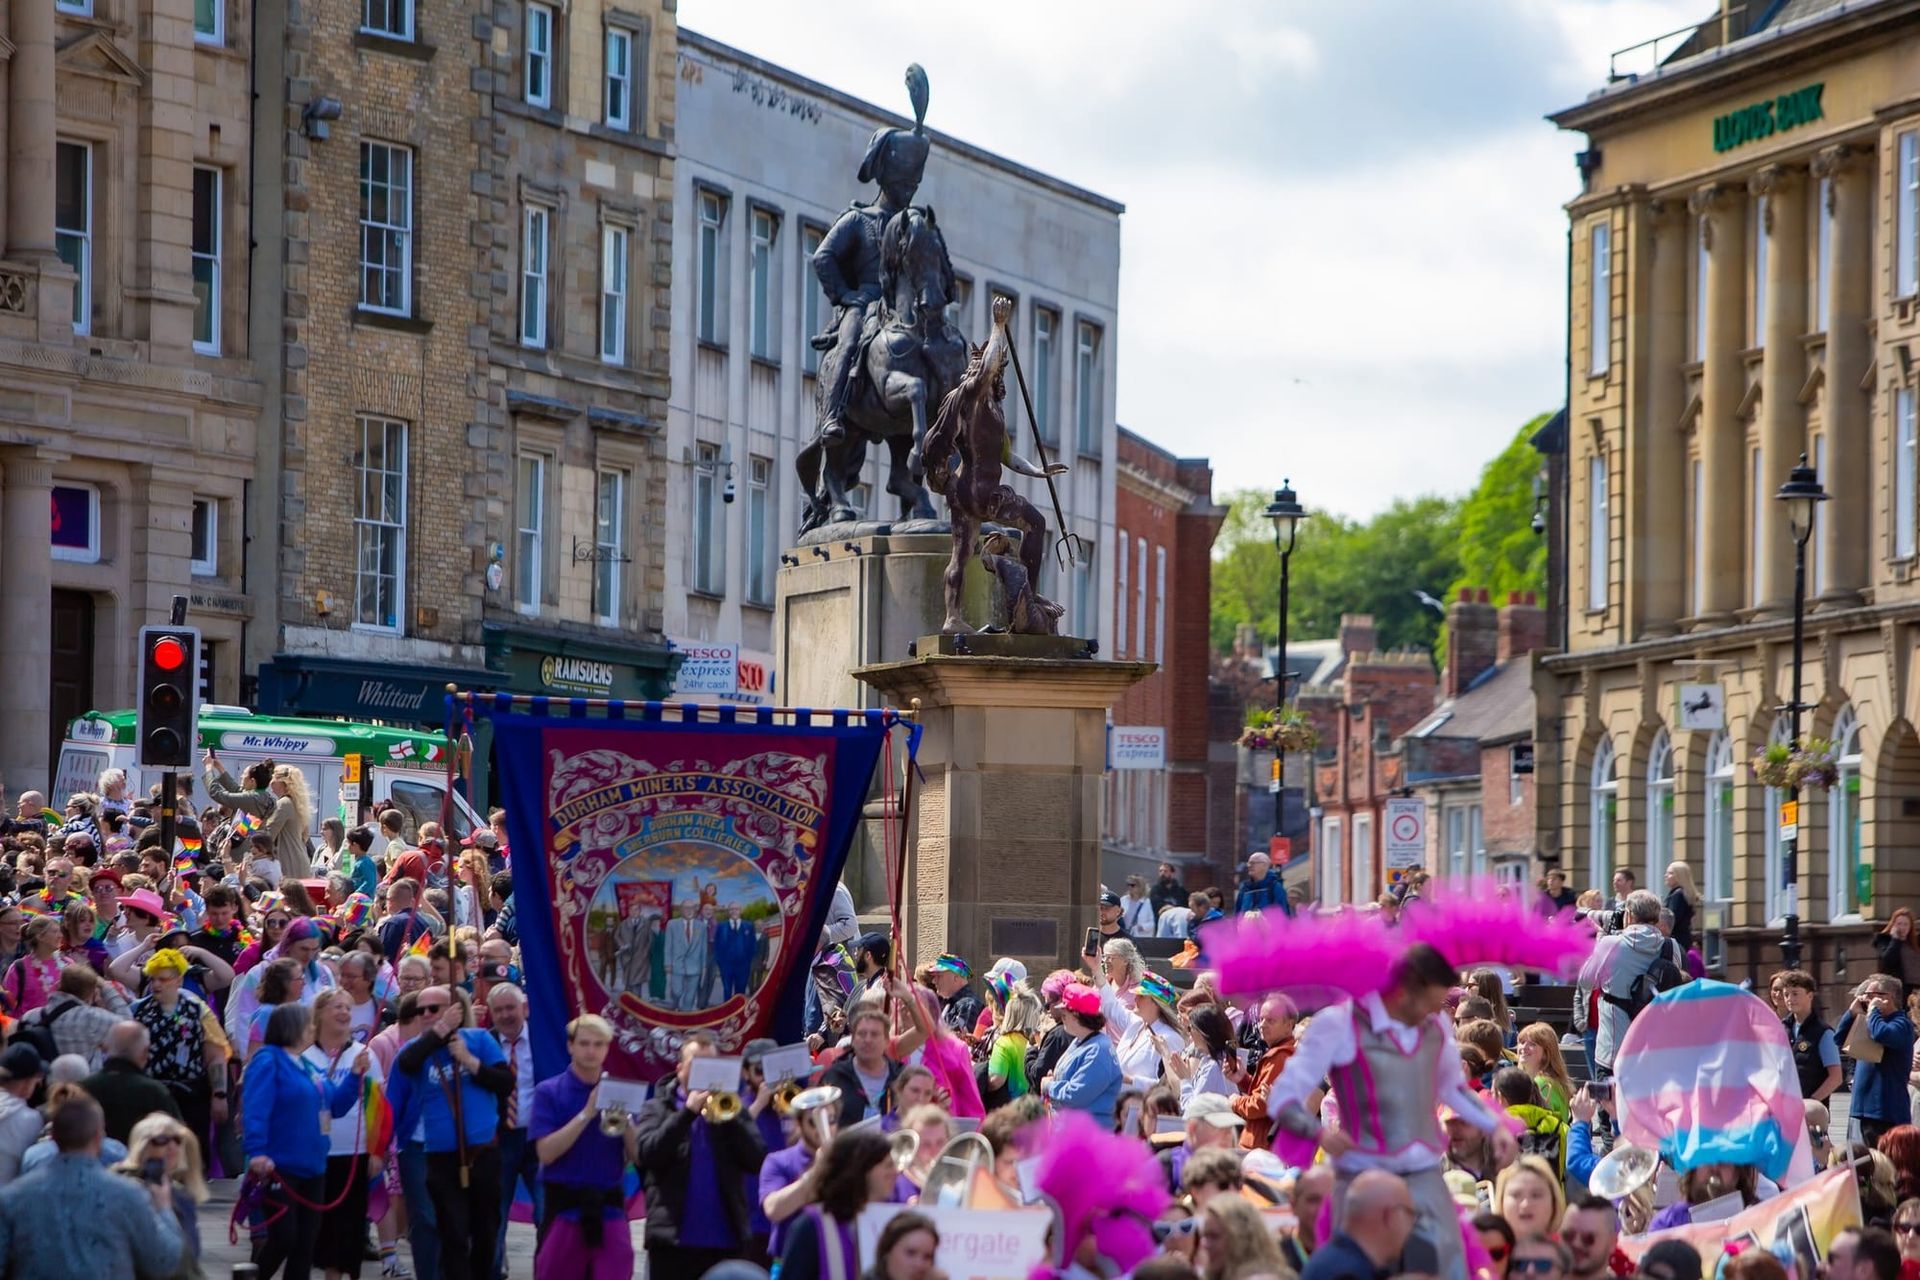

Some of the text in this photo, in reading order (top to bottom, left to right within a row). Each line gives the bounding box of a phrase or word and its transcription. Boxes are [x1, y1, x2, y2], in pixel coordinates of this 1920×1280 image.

[1713, 82, 1825, 153] LLOYDS BANK
[682, 648, 731, 659] TESCO
[554, 657, 613, 685] RAMSDENS
[681, 665, 731, 680] express
[738, 660, 764, 690] SCO
[683, 680, 728, 689] 24hr cash
[357, 681, 428, 709] Whittard
[263, 737, 309, 751] Whippy
[1119, 734, 1160, 743] TESCO
[1117, 751, 1159, 760] express
[555, 787, 623, 827] DURHAM
[706, 779, 819, 827] ASSOCIATION
[696, 815, 725, 832] AREA
[684, 826, 753, 855] COLLIERIES
